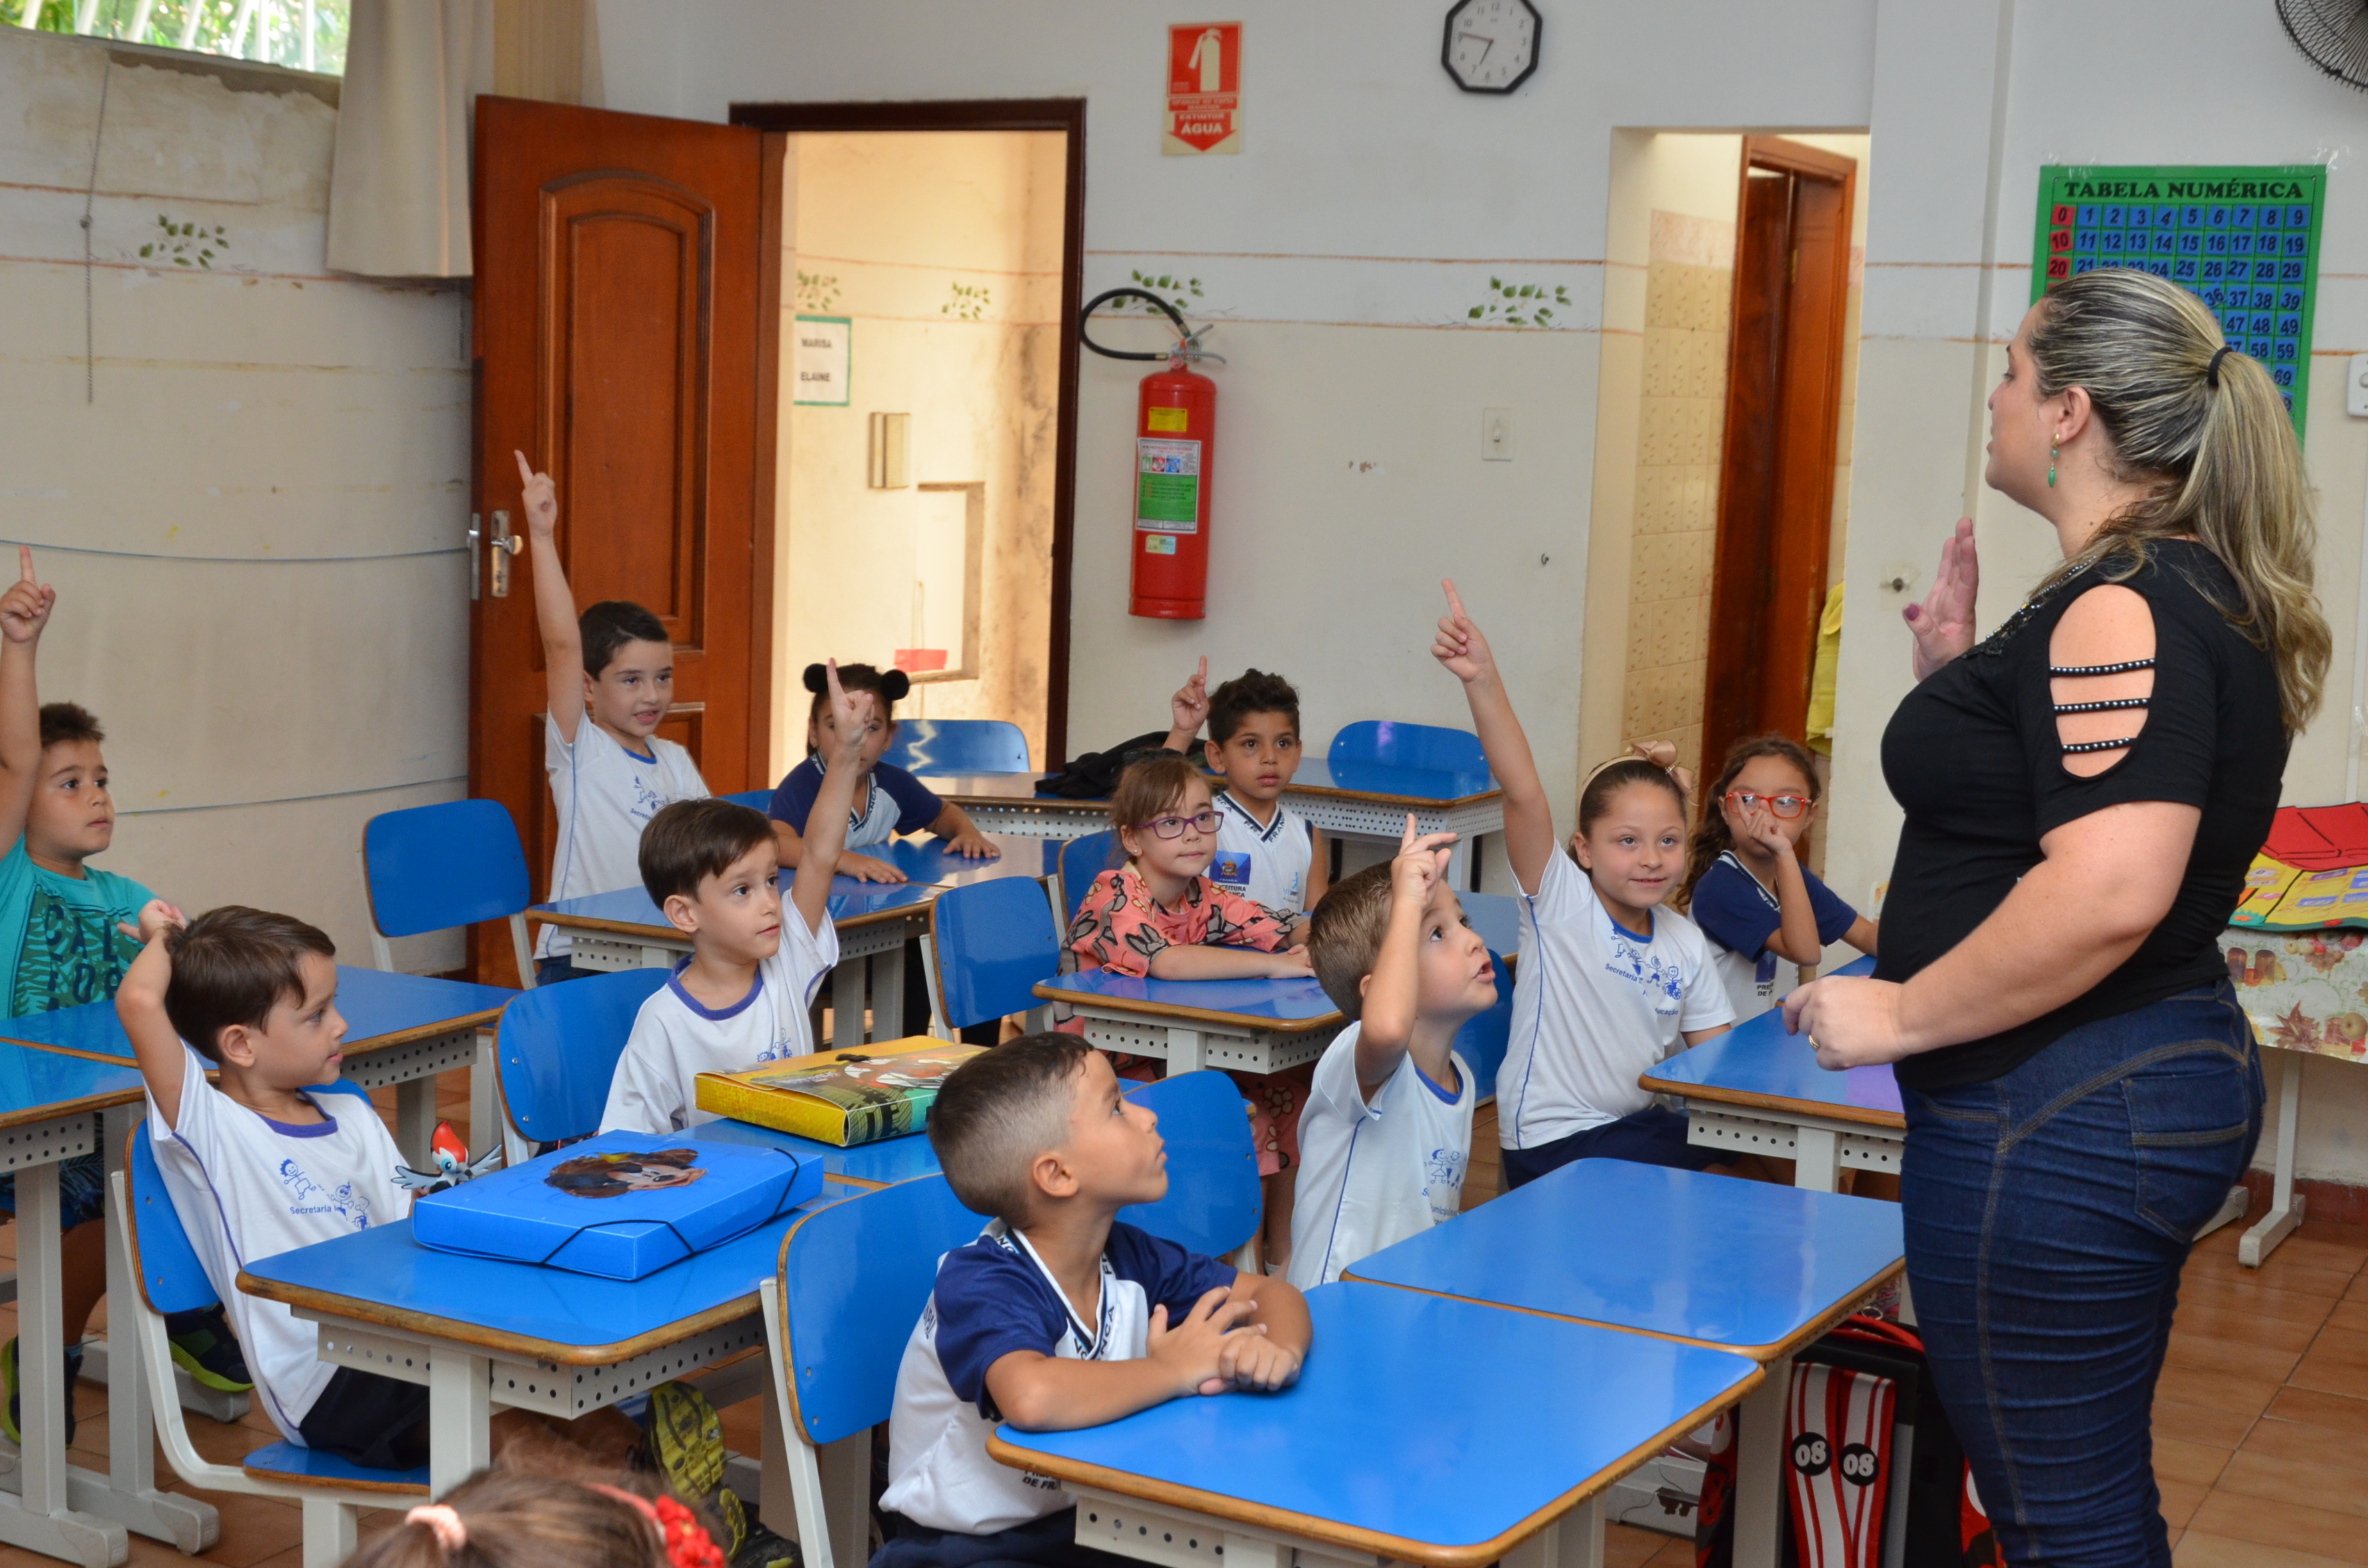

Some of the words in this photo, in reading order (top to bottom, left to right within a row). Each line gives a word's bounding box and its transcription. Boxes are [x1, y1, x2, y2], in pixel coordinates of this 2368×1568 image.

[1477, 6, 1484, 15] 11
[1491, 3, 1500, 11] 12
[1464, 19, 1472, 27] 10
[1518, 20, 1524, 28] 2
[1522, 37, 1527, 46] 3
[1515, 54, 1520, 63] 4
[1485, 70, 1490, 81] 6
[1501, 67, 1506, 75] 5
[1181, 122, 1222, 135] ÁGUA
[2064, 182, 2160, 198] TABELA
[2167, 177, 2303, 199] NUMÉRICA
[2058, 207, 2068, 222] 0
[2086, 208, 2093, 222] 1
[2110, 208, 2119, 223] 2
[2137, 209, 2146, 225] 3
[2160, 211, 2172, 225] 4
[2188, 209, 2197, 224] 5
[2214, 209, 2224, 224] 6
[2240, 209, 2250, 223] 7
[2267, 209, 2276, 225] 8
[2294, 209, 2303, 224] 9
[2051, 233, 2069, 249] 10
[2080, 233, 2096, 249] 11
[2104, 234, 2121, 249] 12
[2130, 234, 2146, 249] 13
[2156, 235, 2172, 250] 14
[2182, 235, 2199, 250] 15
[2208, 235, 2226, 250] 16
[2233, 235, 2250, 251] 17
[2259, 235, 2276, 250] 18
[2286, 238, 2304, 253] 19
[2048, 260, 2067, 275] 20
[2077, 259, 2094, 273] 21
[2151, 263, 2168, 277] 24
[2176, 260, 2195, 277] 25
[2205, 262, 2222, 277] 26
[2228, 261, 2248, 277] 27
[2257, 263, 2274, 277] 28
[2282, 263, 2301, 278] 29
[2205, 288, 2224, 307] 36
[2230, 291, 2247, 306] 37
[2255, 293, 2272, 309] 38
[2282, 292, 2300, 309] 39
[2226, 316, 2245, 331] 47
[2253, 316, 2270, 332] 48
[2281, 318, 2298, 334] 49
[2251, 343, 2268, 357] 58
[2278, 344, 2294, 360] 59
[801, 372, 830, 382] ELAINE
[44, 904, 118, 962] CAL
[1605, 963, 1638, 982] Secretaria
[1655, 1008, 1679, 1017] ucação
[290, 1205, 332, 1214] Secretaria
[1795, 1441, 1826, 1467] 08
[1843, 1453, 1874, 1477] 08
[1023, 1476, 1039, 1487] DE
[1040, 1480, 1057, 1490] FR
